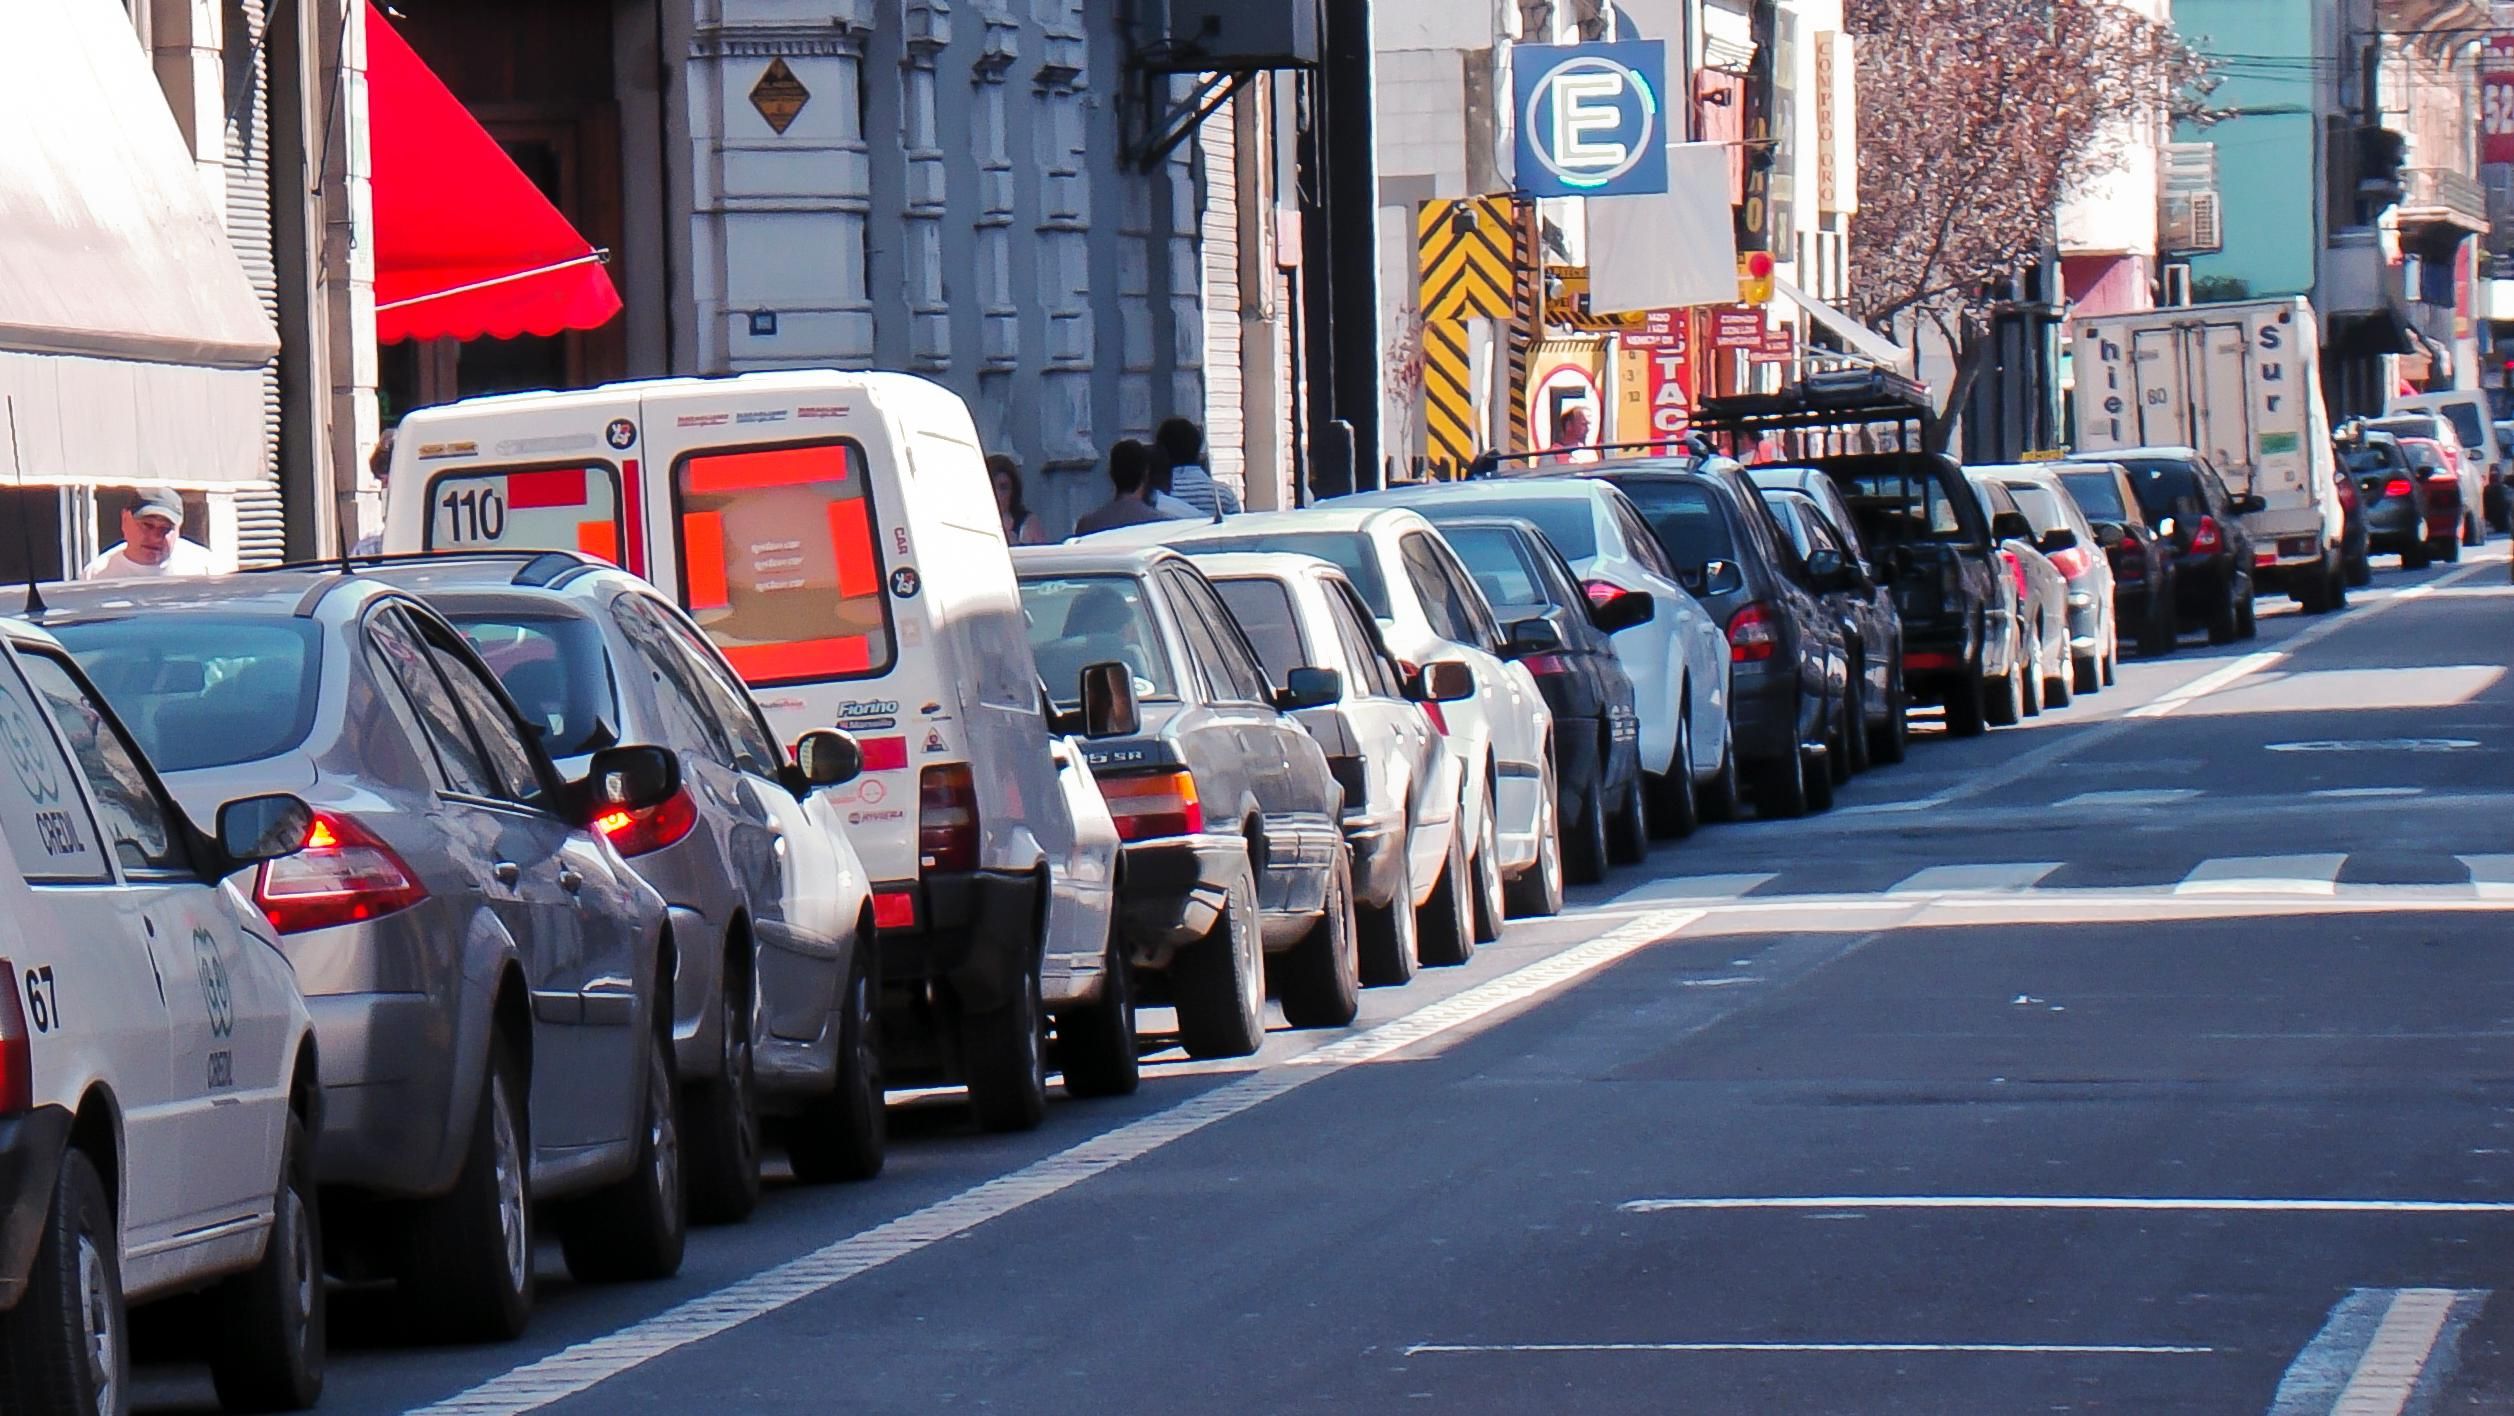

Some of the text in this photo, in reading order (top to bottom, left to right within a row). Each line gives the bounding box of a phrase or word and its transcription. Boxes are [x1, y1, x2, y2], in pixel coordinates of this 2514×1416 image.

[1551, 72, 1627, 168] E
[443, 488, 504, 542] 110
[837, 699, 899, 717] Fiorino
[1083, 752, 1108, 764] 5
[35, 811, 86, 856] CREDIL
[26, 965, 59, 1033] 67
